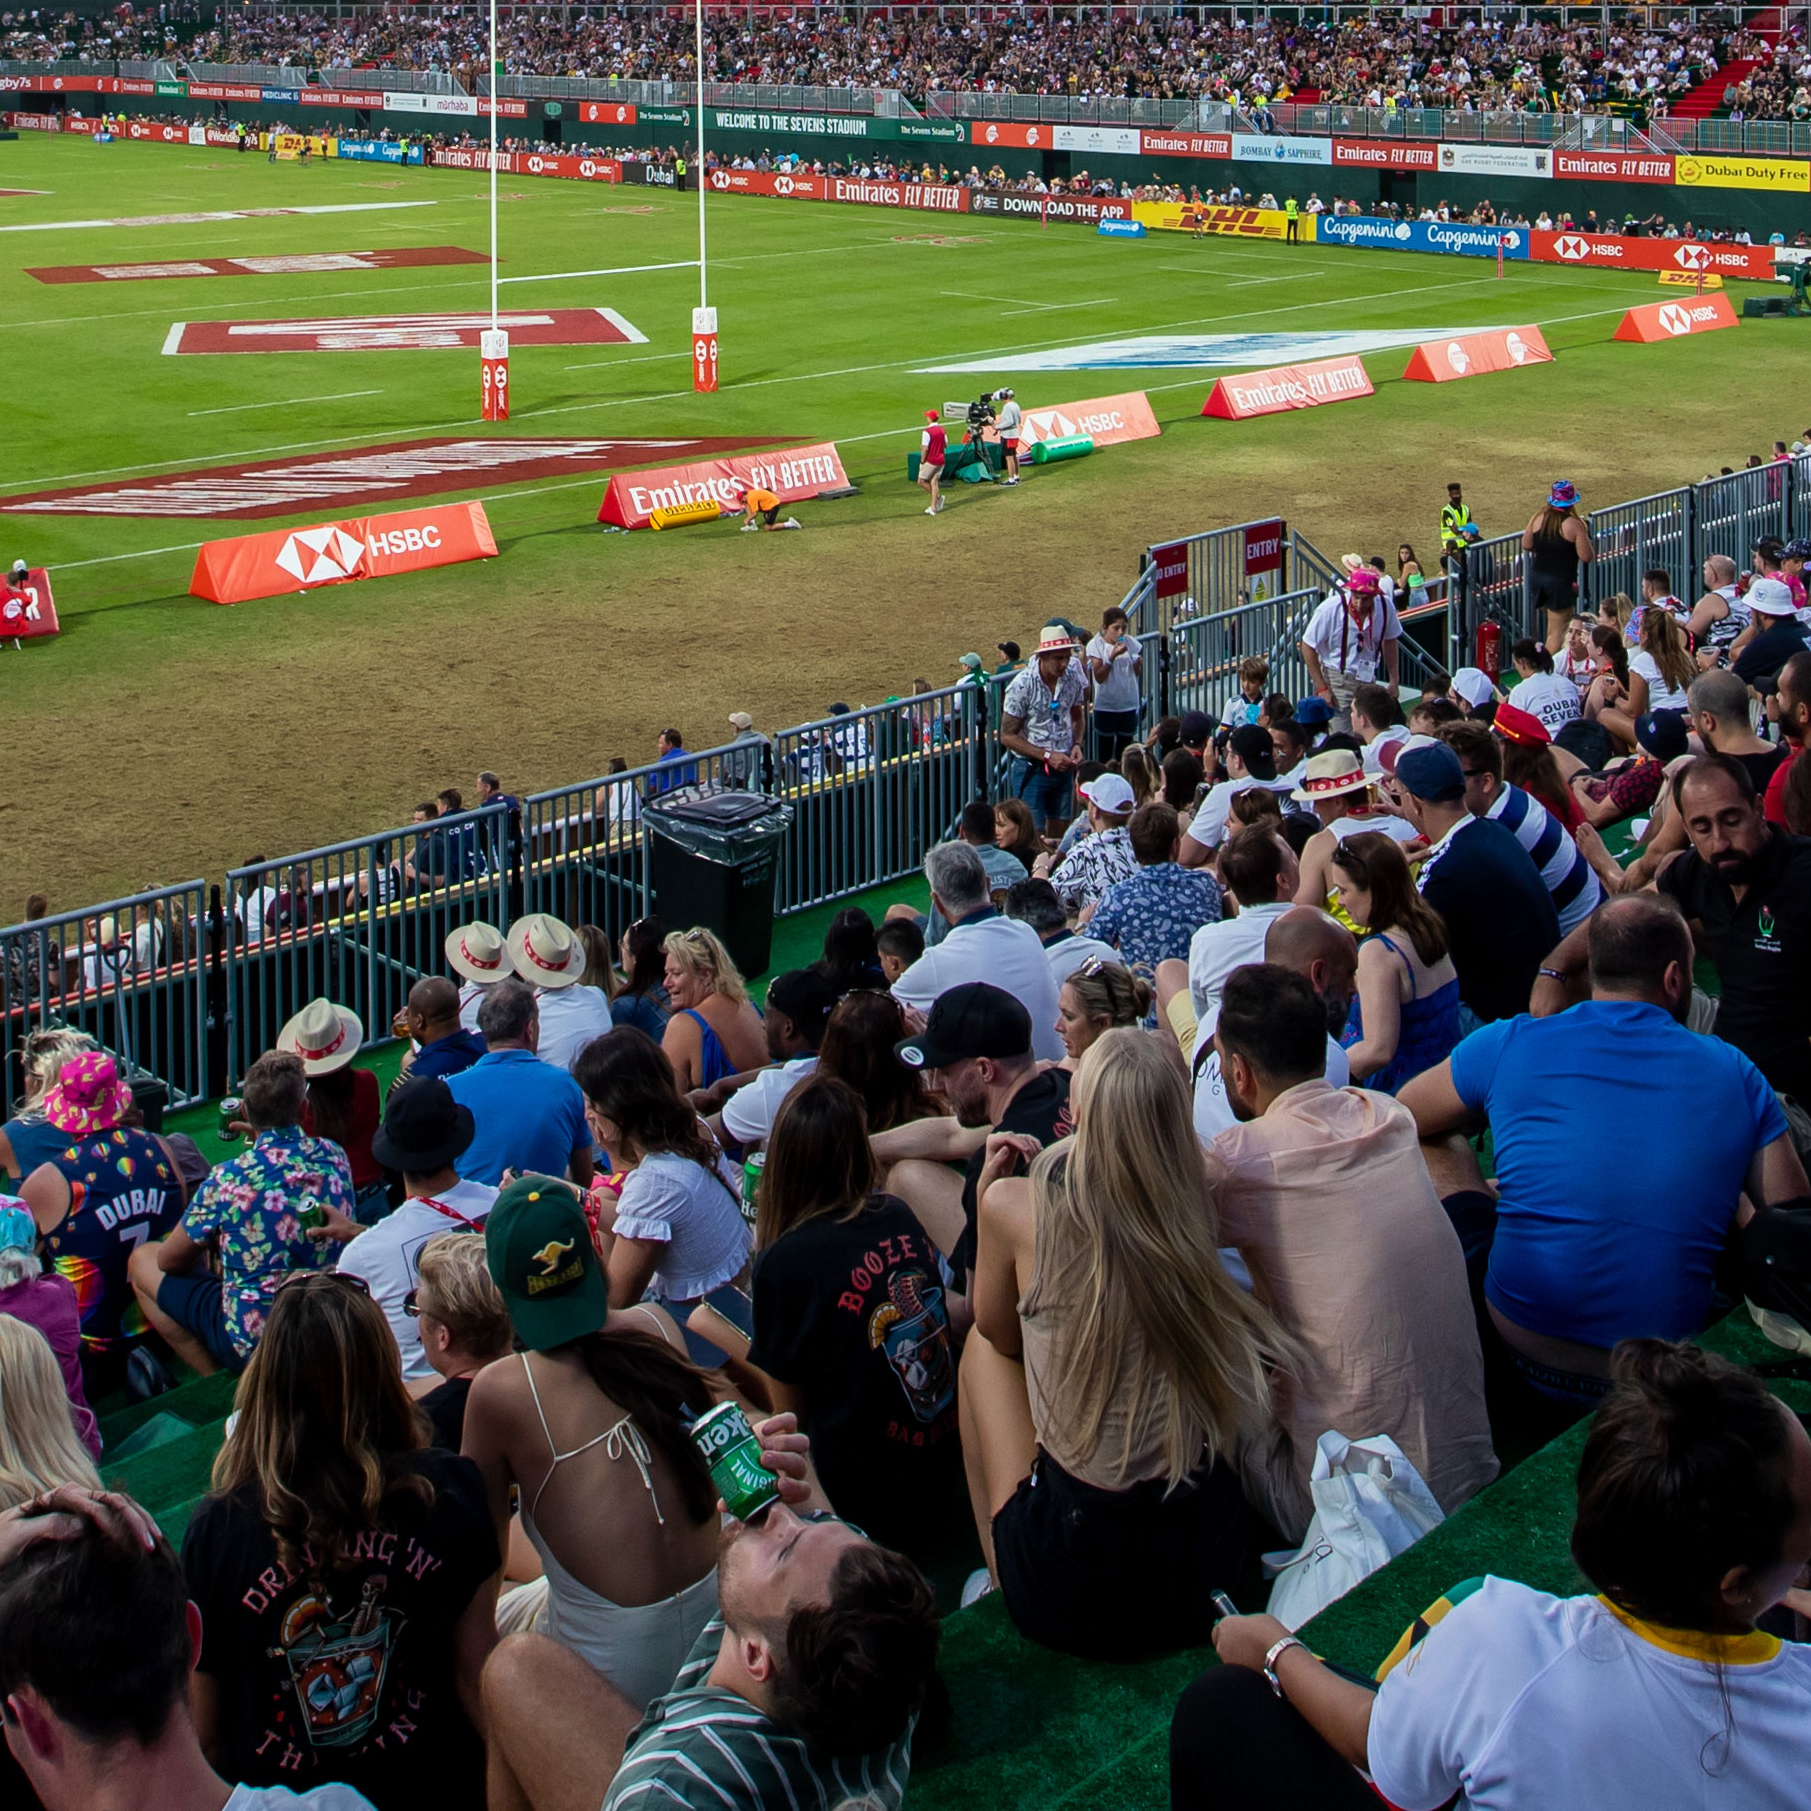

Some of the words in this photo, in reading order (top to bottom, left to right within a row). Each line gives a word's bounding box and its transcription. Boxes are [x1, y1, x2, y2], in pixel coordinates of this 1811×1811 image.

[262, 90, 292, 100] MEDICLINIC
[437, 100, 469, 112] marhaba
[716, 112, 756, 129] WELCOME
[758, 114, 770, 129] TO
[772, 115, 788, 131] THE
[790, 116, 825, 133] SEVENS
[827, 118, 867, 135] STADIUM
[901, 125, 913, 134] The
[914, 127, 931, 136] Sevens
[932, 126, 954, 137] Stadium
[1144, 135, 1188, 152] Emirates
[1190, 137, 1203, 152] FLY
[1203, 138, 1228, 154] BETTER
[1240, 145, 1272, 157] BOMBAY
[1287, 148, 1322, 160] SAPPHIRE
[1336, 146, 1387, 163] Emirates
[1391, 148, 1405, 163] FLY
[1406, 149, 1433, 165] BETTER
[646, 164, 674, 185] Dubai
[1558, 158, 1617, 175] Emirates
[1621, 160, 1637, 176] FLY
[1638, 161, 1671, 177] BETTER
[1706, 164, 1742, 178] Dubai
[1746, 167, 1776, 181] Duty
[1780, 167, 1808, 180] Free
[836, 180, 900, 204] Emirates
[905, 184, 922, 206] FLY
[923, 186, 960, 209] BETTER
[1003, 197, 1076, 218] DOWNLOAD
[1078, 203, 1098, 217] THE
[1100, 205, 1124, 219] APP
[1180, 206, 1265, 235] DHL
[1324, 217, 1394, 242] Capgemini
[1427, 225, 1501, 251] Capgemini
[1592, 244, 1623, 257] HSBC
[1715, 253, 1749, 267] HSBC
[1667, 273, 1709, 285] DHL
[1689, 306, 1718, 322] HSBC
[1231, 377, 1306, 410] Emirates
[1307, 373, 1327, 396] FLY
[1327, 366, 1365, 393] BETTER
[1077, 411, 1124, 434] HSBC
[628, 476, 742, 515] Emirates
[751, 464, 776, 489] FLY
[782, 455, 837, 489] BETTER
[369, 525, 442, 558] HSBC
[1247, 538, 1279, 561] ENTRY
[1163, 562, 1186, 578] ENTRY
[95, 1188, 166, 1230] DUBAI
[838, 1235, 917, 1316] BOOZE
